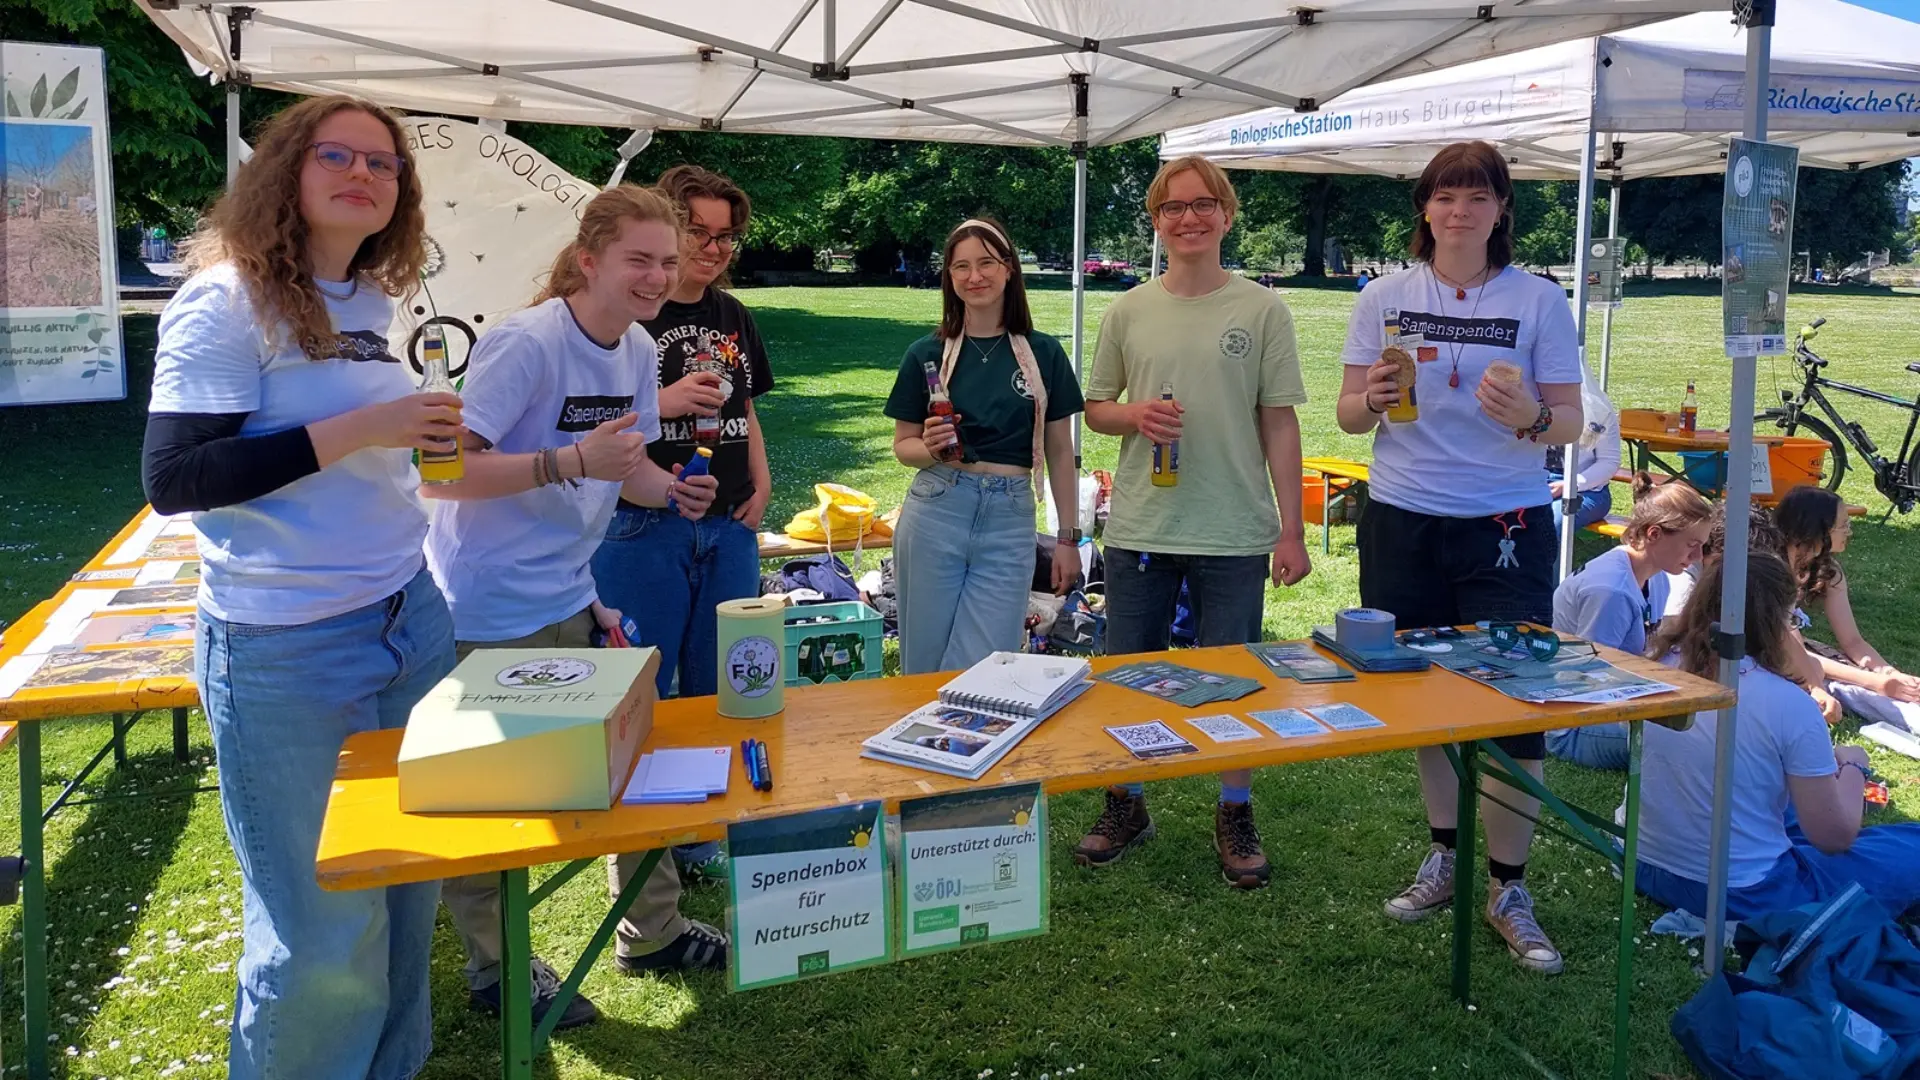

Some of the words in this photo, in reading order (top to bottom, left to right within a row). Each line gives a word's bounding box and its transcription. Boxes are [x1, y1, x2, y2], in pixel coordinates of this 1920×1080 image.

[1230, 111, 1352, 146] BiologischeStation
[1360, 108, 1410, 129] Haus
[1423, 89, 1503, 125] Bürgel
[1400, 317, 1515, 341] Samenspender
[731, 662, 775, 680] FÖJ
[911, 837, 990, 860] Unterstützt
[993, 831, 1037, 848] durch:
[751, 857, 868, 892] Spendenbox
[798, 890, 826, 909] für
[936, 877, 961, 900] ÖPJ
[754, 911, 870, 946] Naturschutz
